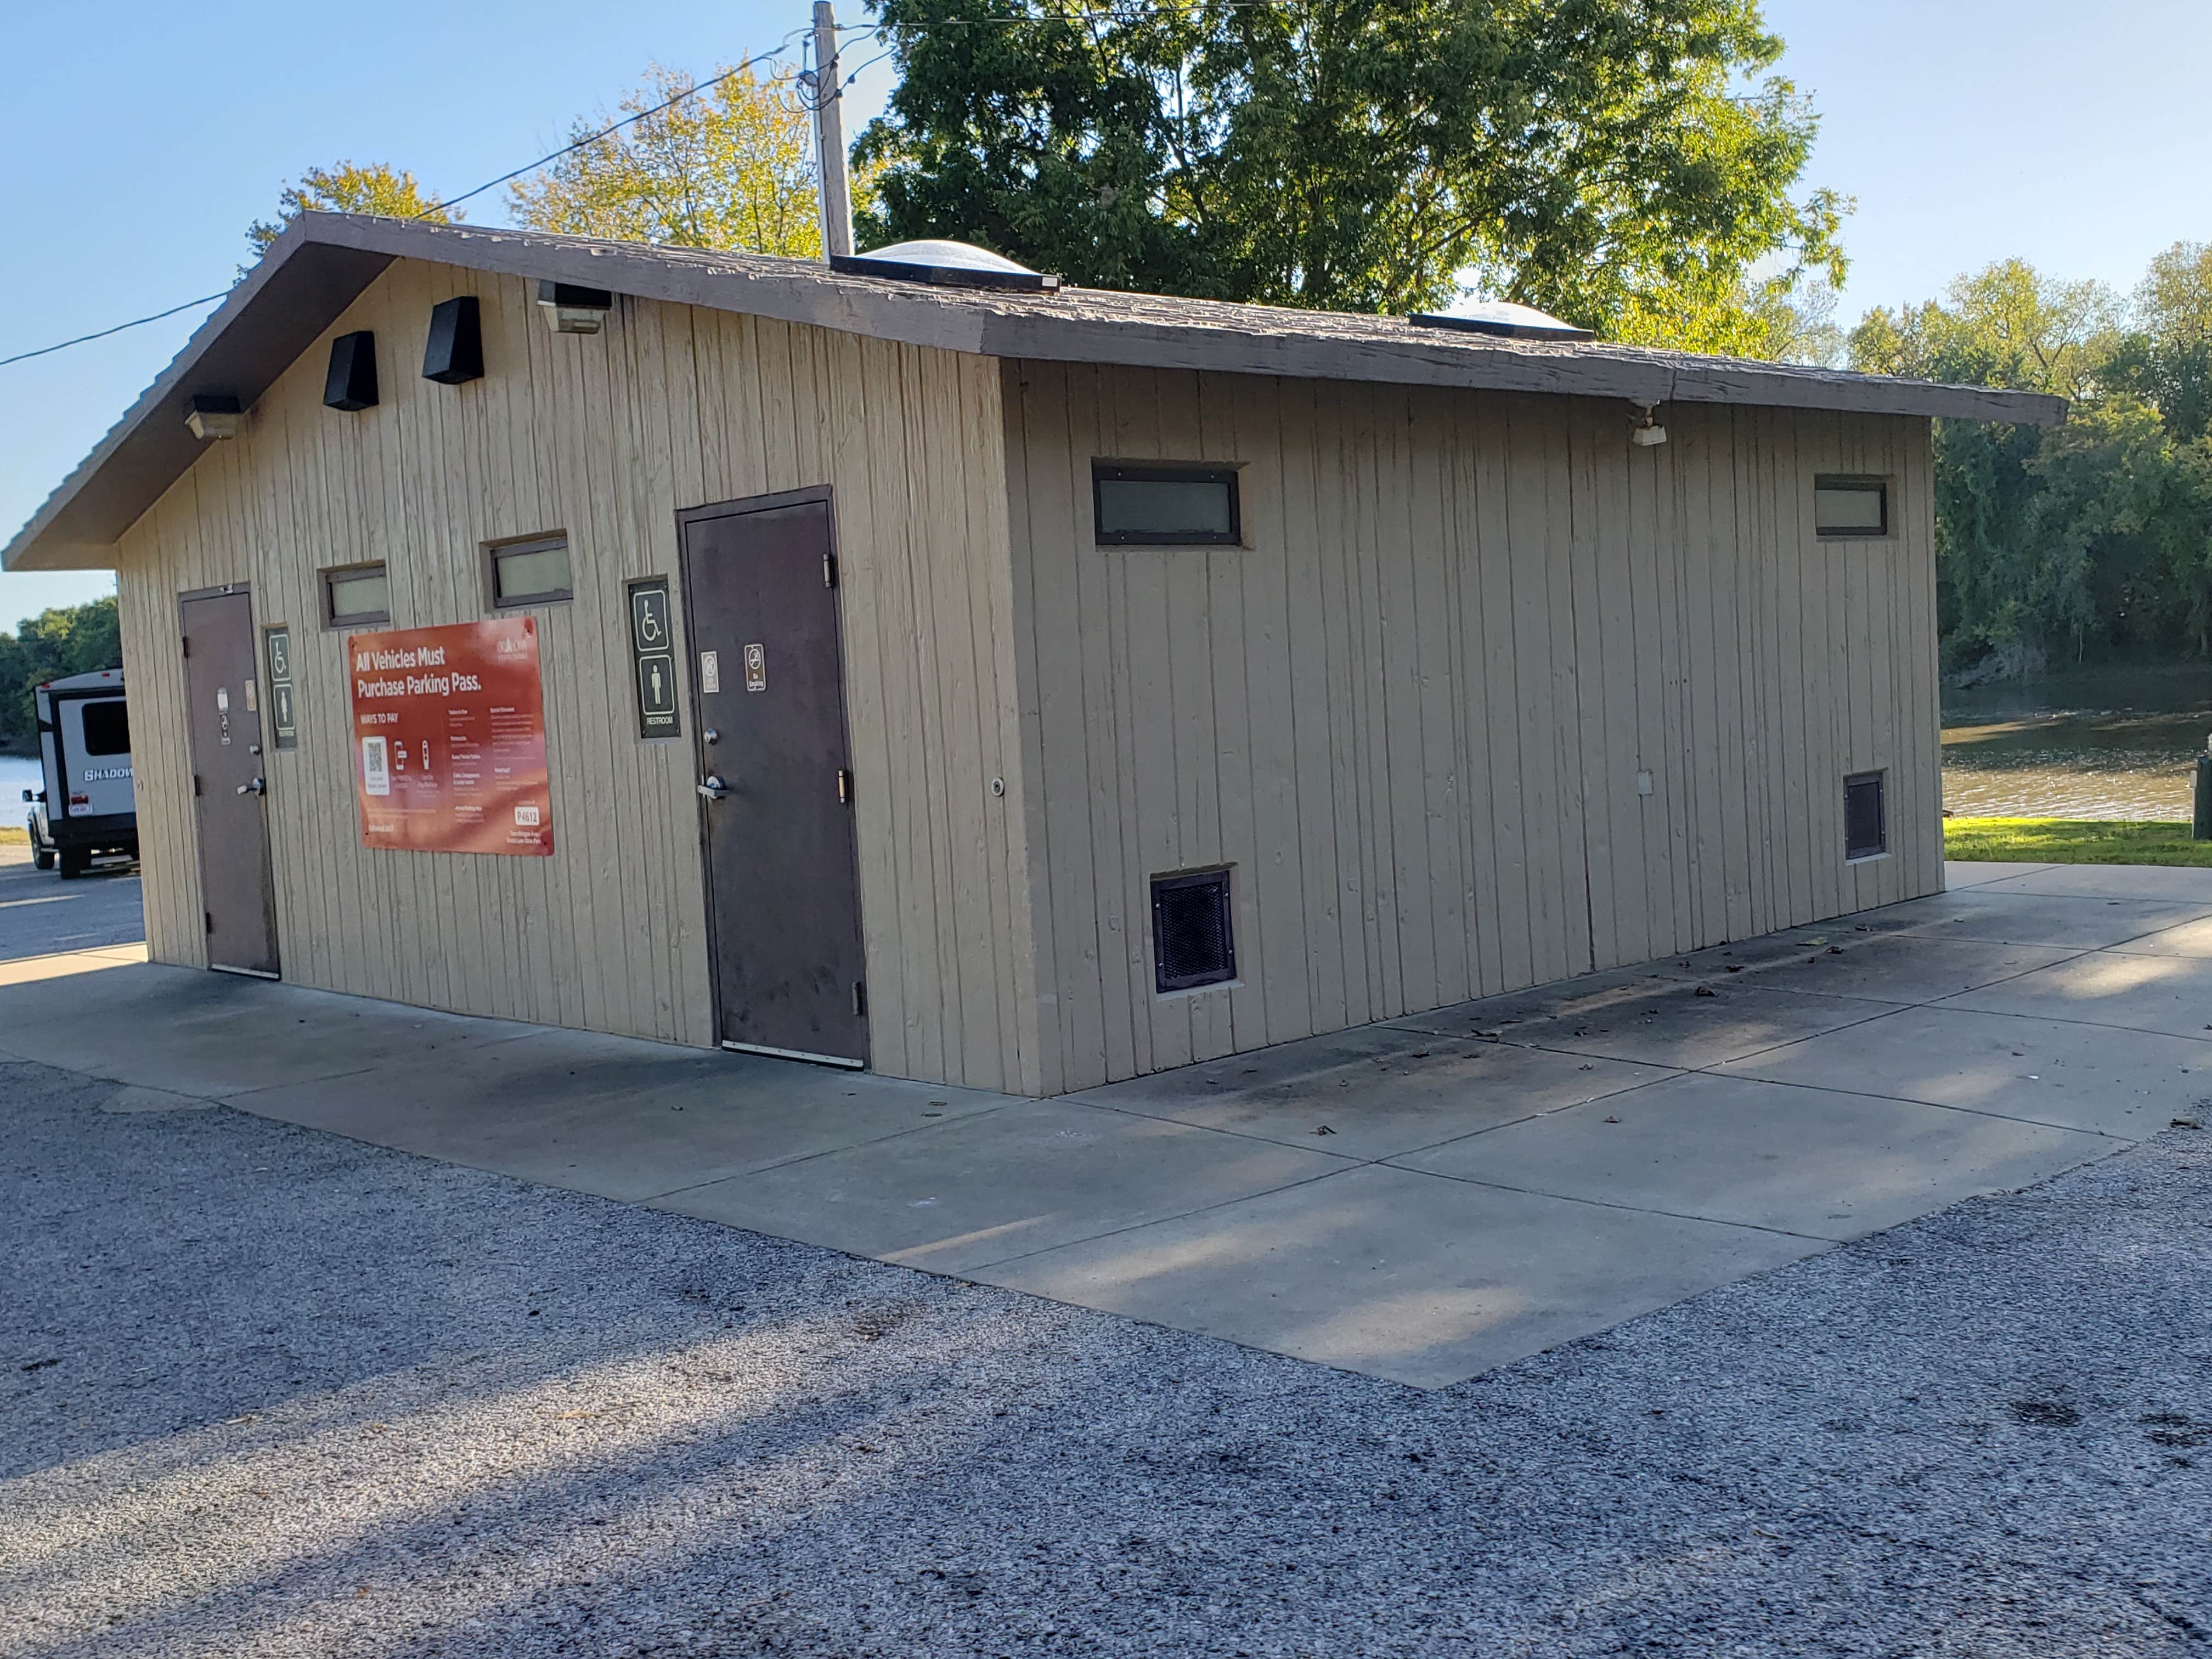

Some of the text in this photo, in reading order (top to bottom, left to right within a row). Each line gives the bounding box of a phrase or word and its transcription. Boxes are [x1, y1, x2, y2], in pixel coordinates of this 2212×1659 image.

[357, 646, 445, 672] All Vehicles Must
[358, 672, 481, 698] Purchase Parking Pass.
[360, 713, 399, 724] WAYS TO PAY
[646, 716, 673, 724] RESTROOM
